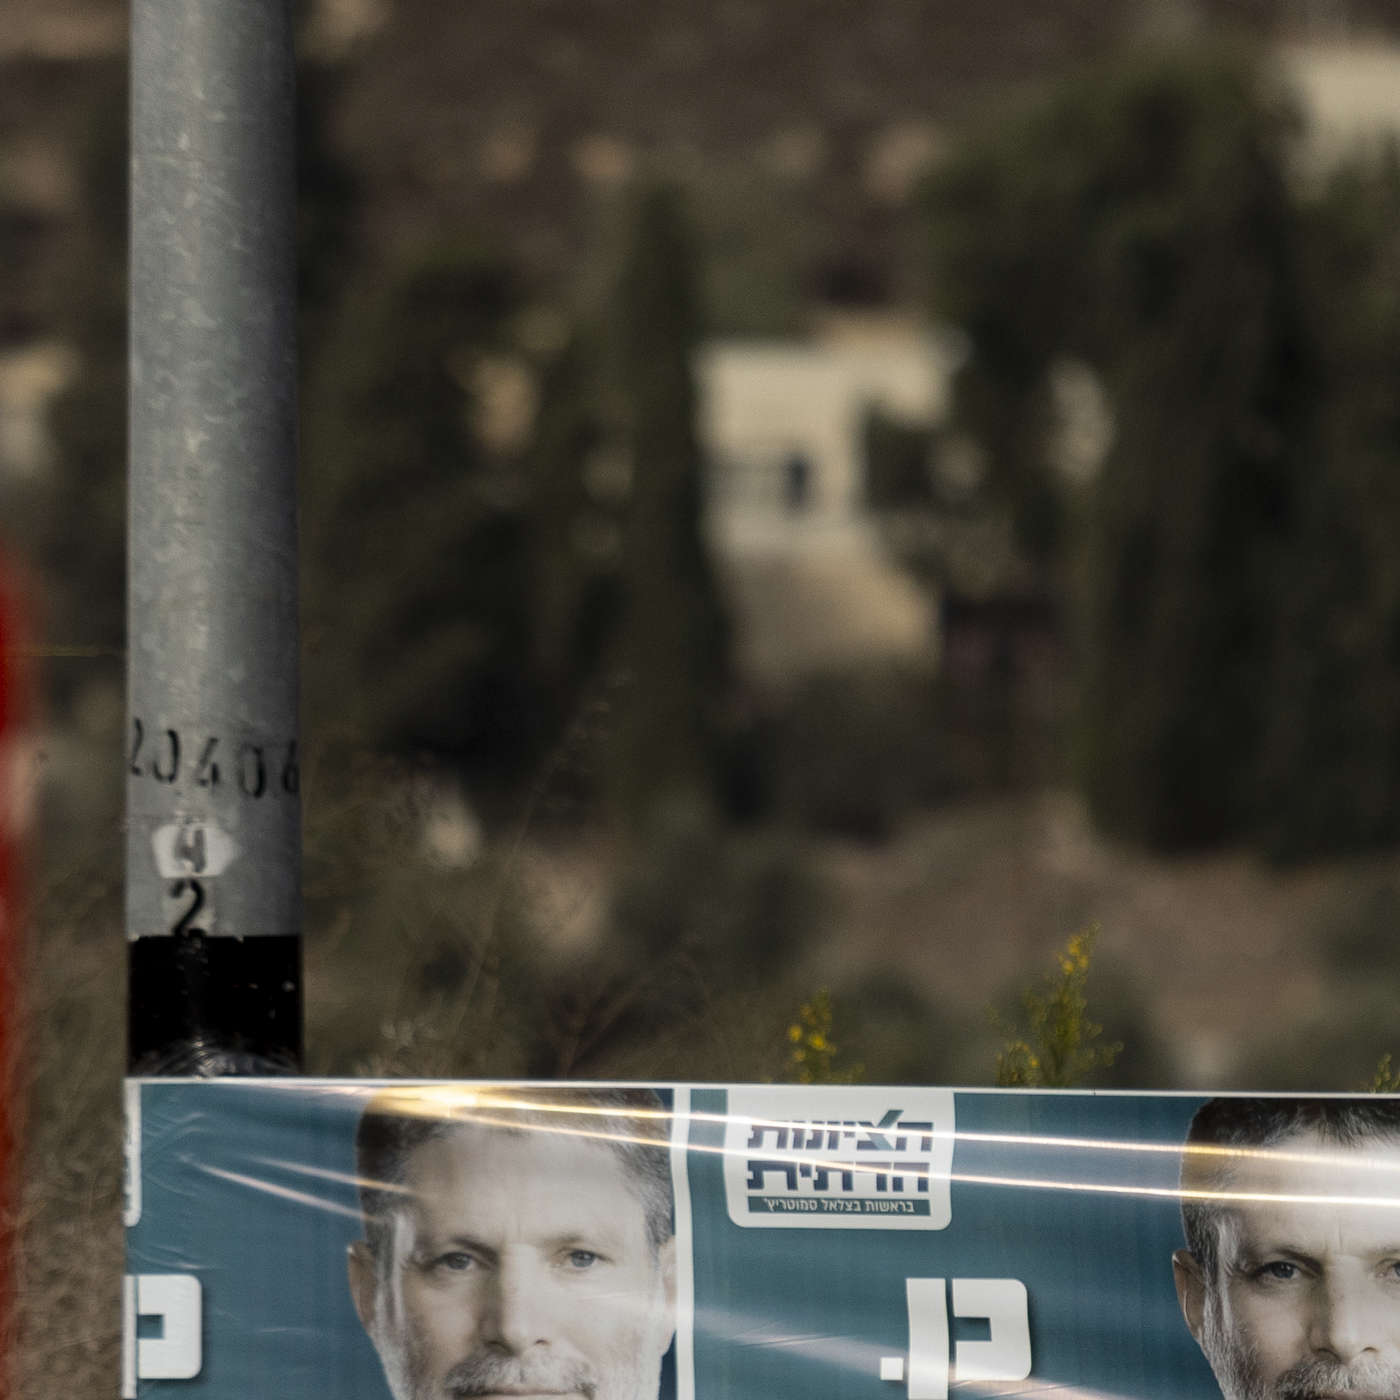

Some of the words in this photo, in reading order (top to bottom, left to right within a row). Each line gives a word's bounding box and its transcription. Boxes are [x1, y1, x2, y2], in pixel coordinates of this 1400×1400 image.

[169, 877, 208, 937] 2
[747, 1109, 934, 1152] הציונות
[746, 1160, 931, 1193] הדתית
